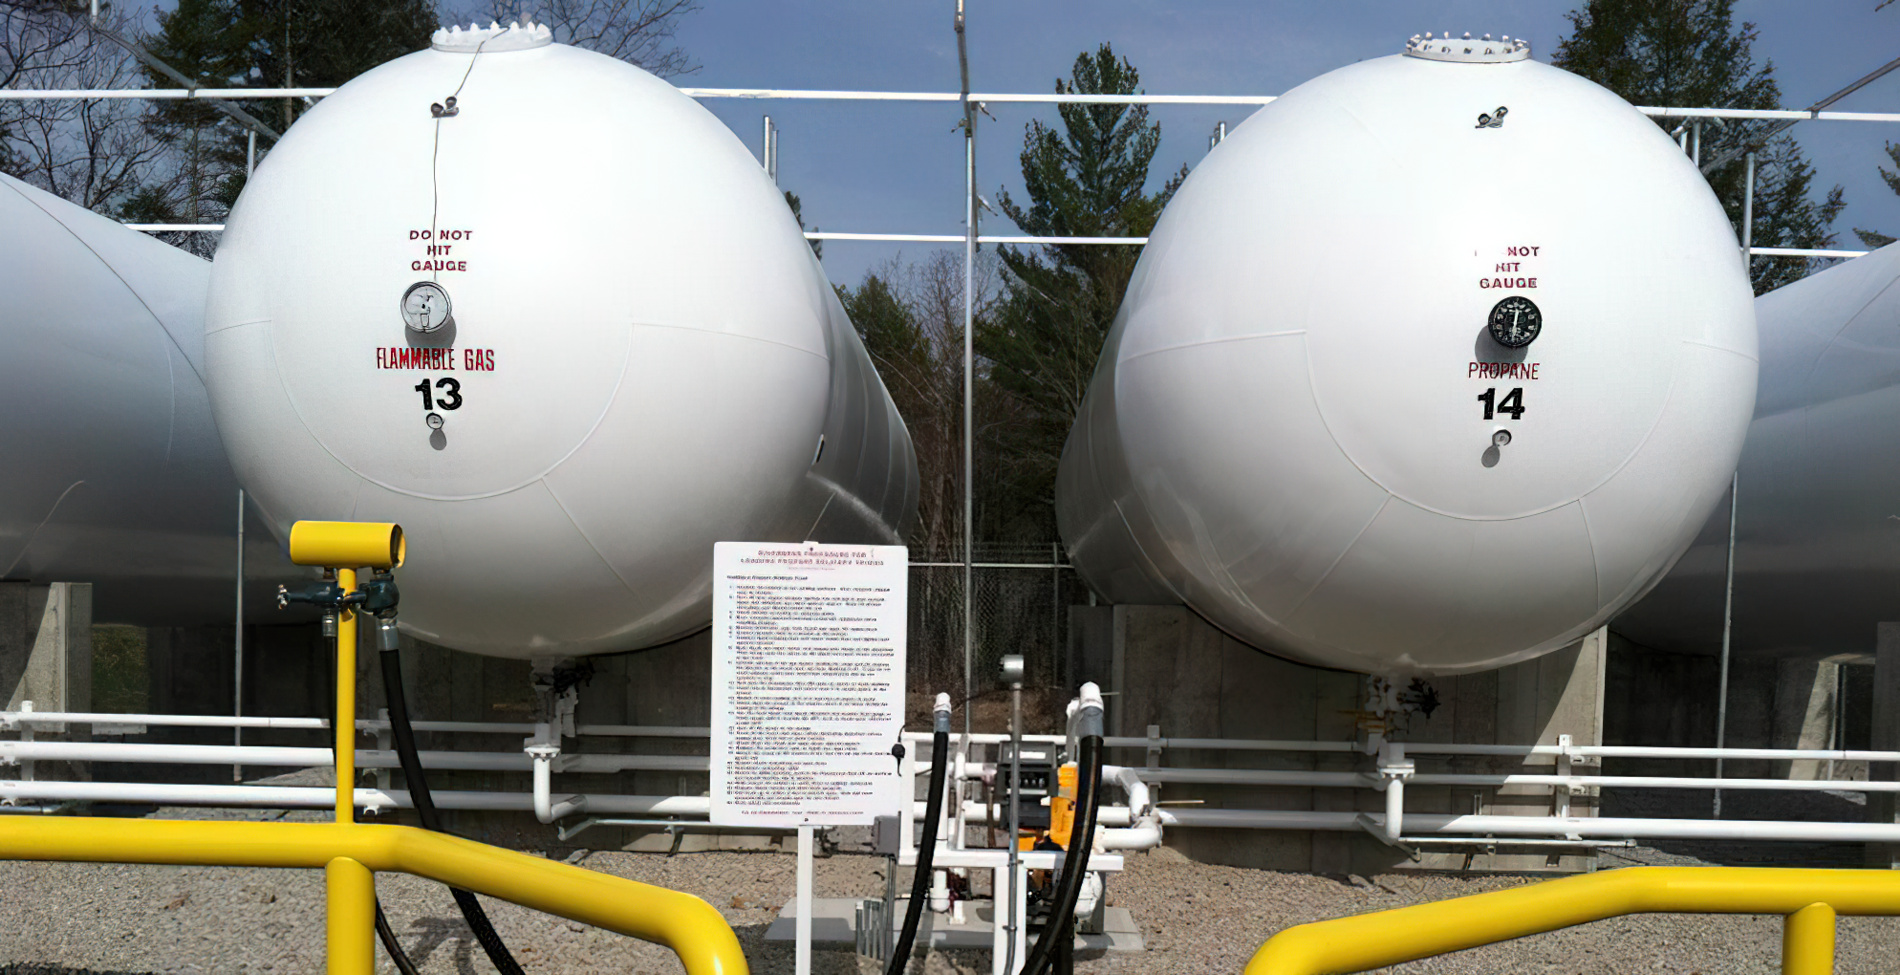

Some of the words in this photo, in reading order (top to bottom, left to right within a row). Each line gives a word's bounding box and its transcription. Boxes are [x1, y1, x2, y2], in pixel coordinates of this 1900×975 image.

[409, 229, 432, 240] DO
[440, 229, 473, 240] NOT
[427, 245, 452, 256] HIT
[1507, 246, 1540, 257] NOT
[411, 260, 467, 271] GAUGE
[1496, 262, 1521, 272] HIT
[1480, 278, 1538, 289] GAUGE
[376, 347, 455, 371] FLAMMABLE
[464, 349, 495, 372] GAS
[1468, 362, 1540, 380] PROPANE
[415, 377, 463, 411] 13
[1478, 387, 1526, 420] 14
